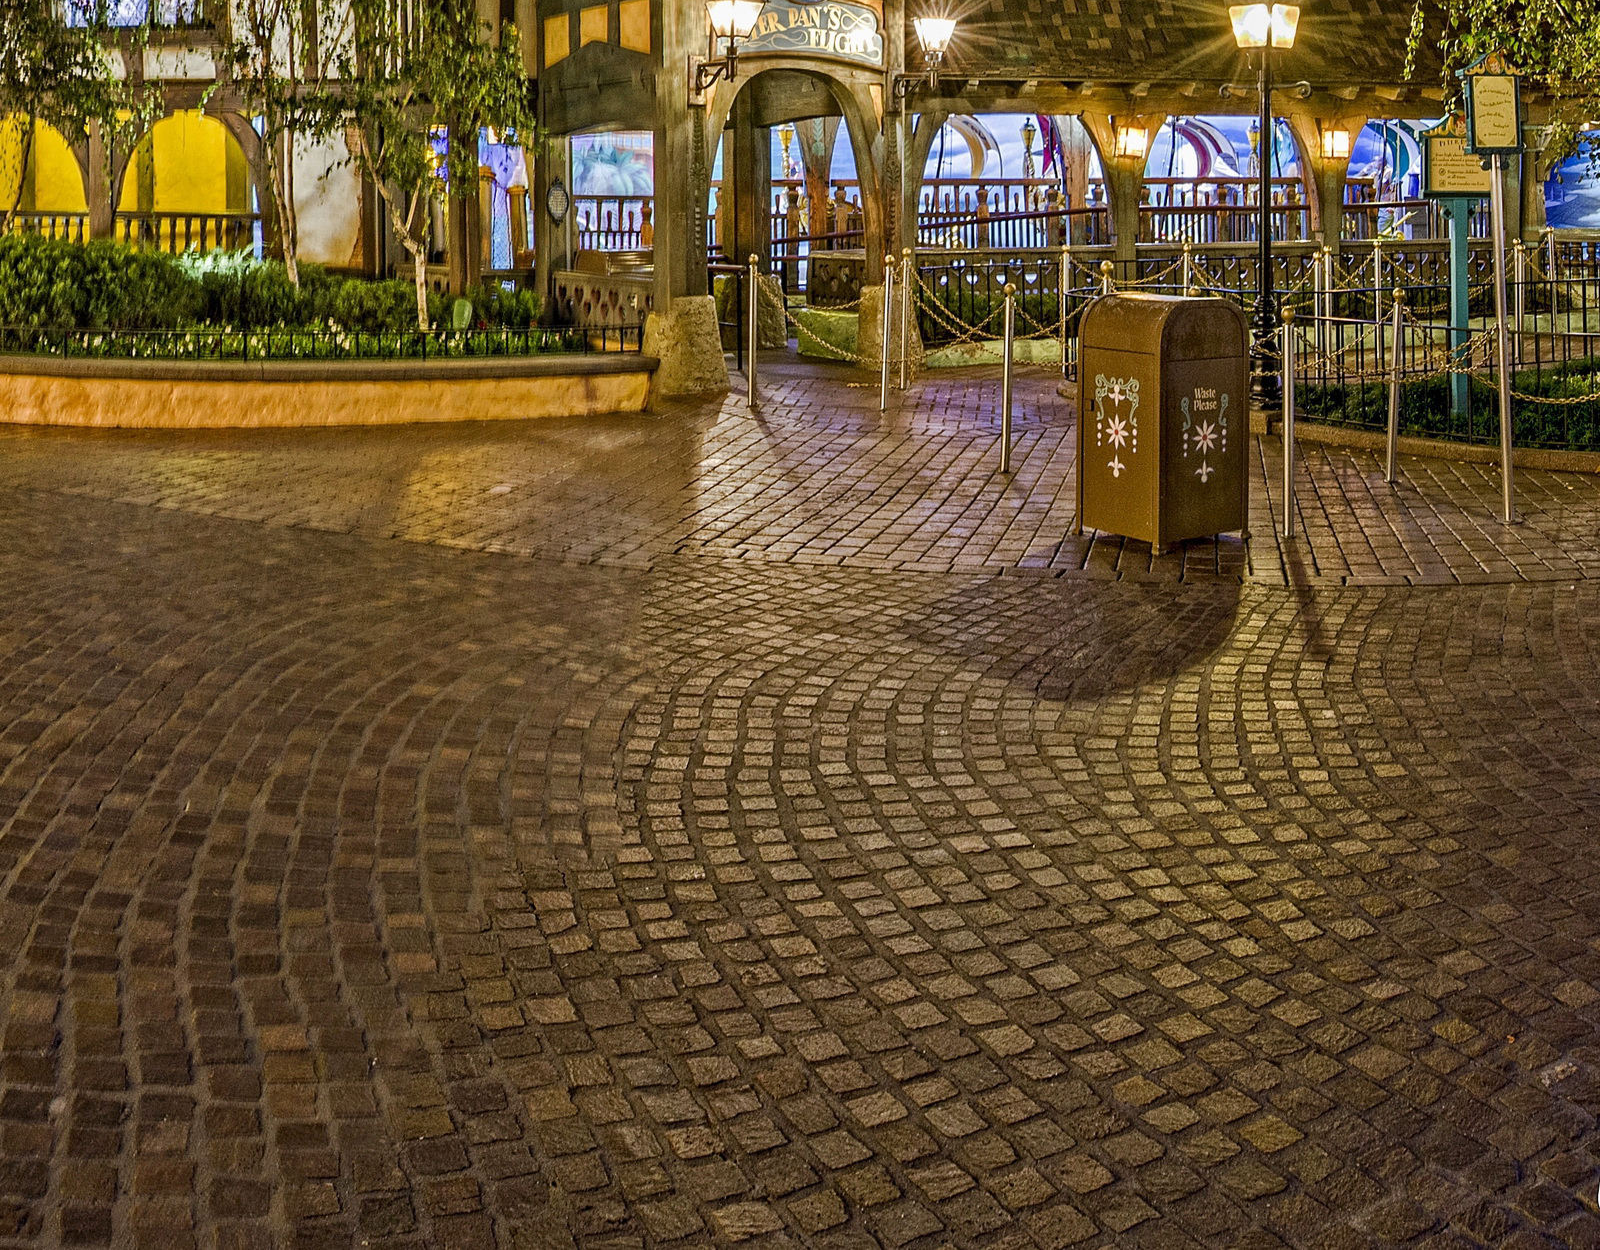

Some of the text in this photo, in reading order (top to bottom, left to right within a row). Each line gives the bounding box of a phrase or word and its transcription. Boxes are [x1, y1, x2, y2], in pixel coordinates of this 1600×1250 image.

[788, 5, 842, 31] PAN'S
[1194, 387, 1216, 399] Waste
[1193, 399, 1218, 411] Please
